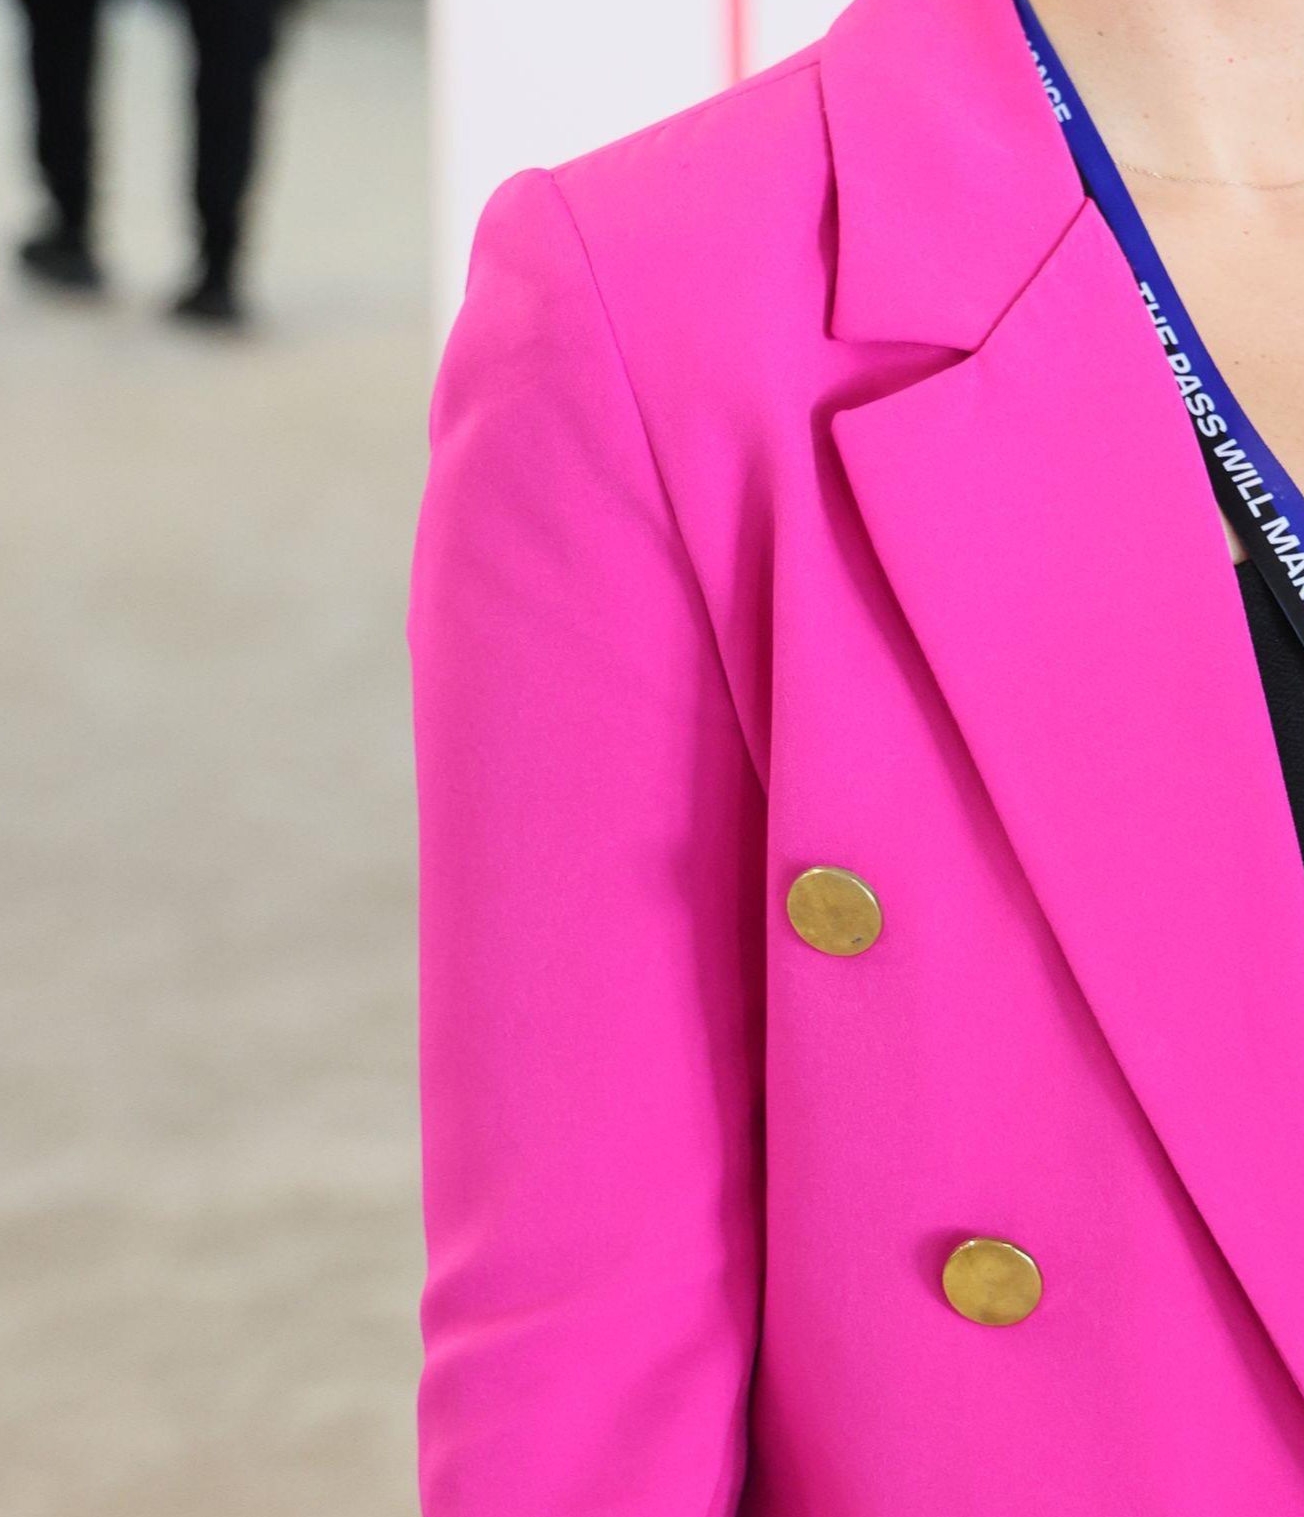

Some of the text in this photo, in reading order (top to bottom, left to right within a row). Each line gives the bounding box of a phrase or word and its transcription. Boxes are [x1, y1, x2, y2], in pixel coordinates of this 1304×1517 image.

[1140, 281, 1179, 346] THE
[1167, 352, 1228, 438] PASS
[1213, 438, 1274, 518] WILL
